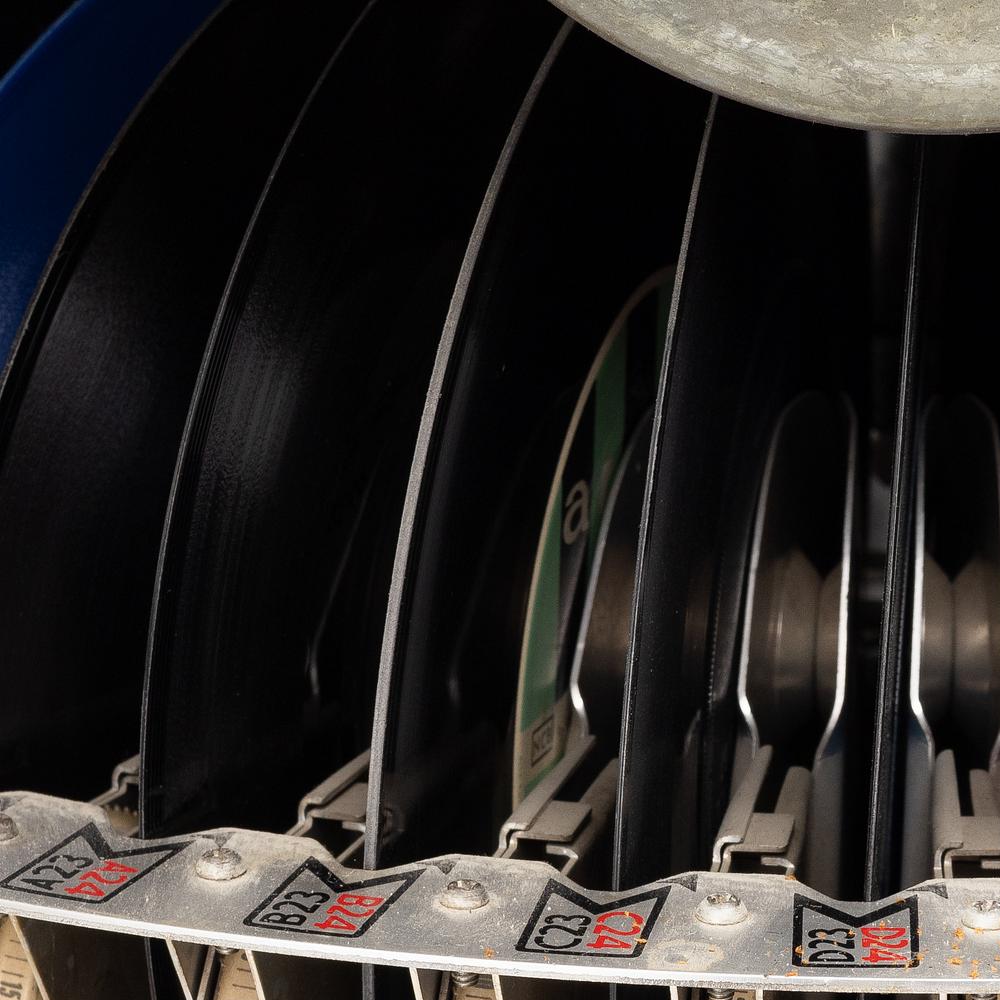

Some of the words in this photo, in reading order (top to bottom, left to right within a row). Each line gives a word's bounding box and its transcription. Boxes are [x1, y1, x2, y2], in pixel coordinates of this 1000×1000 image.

[20, 854, 94, 891] A23
[64, 860, 138, 897] A24
[260, 891, 331, 926] B23
[313, 893, 385, 932] B24
[534, 915, 591, 950] C23
[586, 911, 644, 949] C24
[808, 928, 856, 963] D23
[861, 927, 909, 963] D24
[0, 981, 22, 1000] 15
